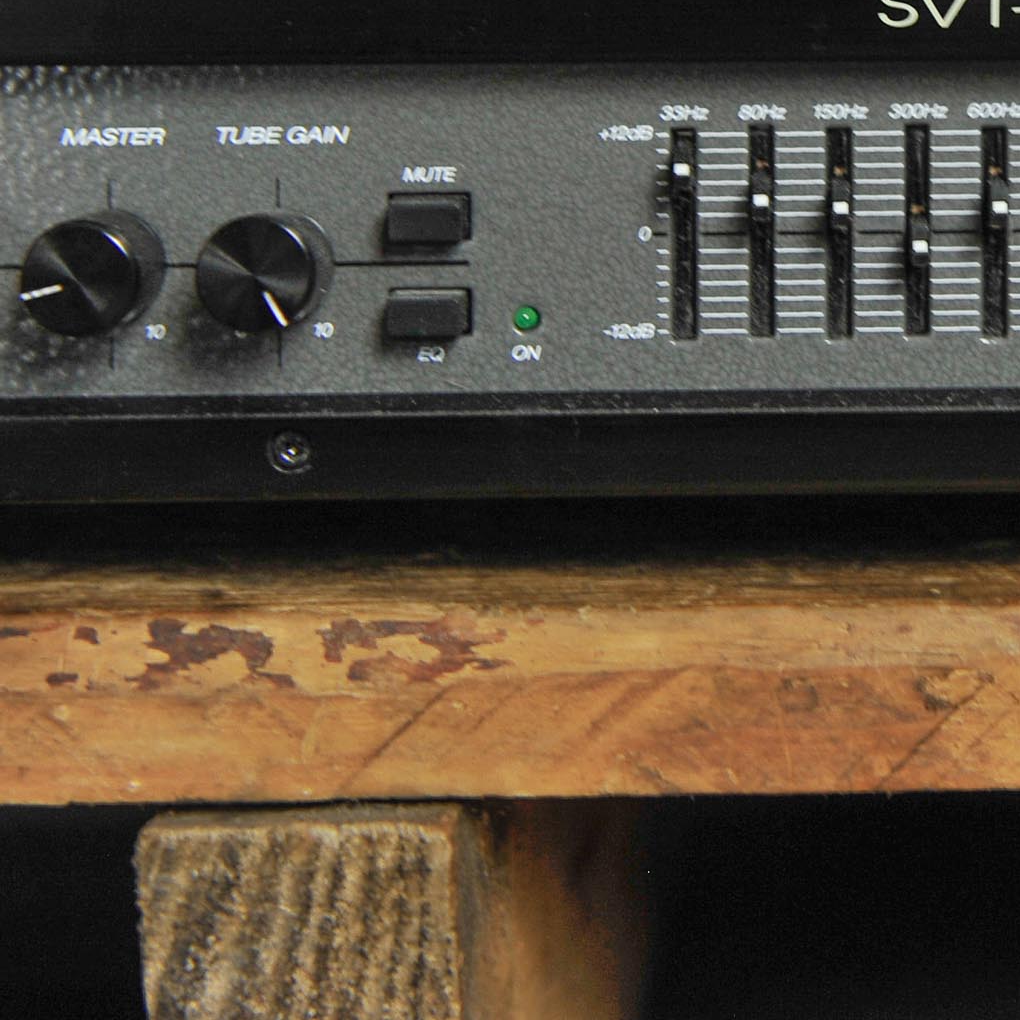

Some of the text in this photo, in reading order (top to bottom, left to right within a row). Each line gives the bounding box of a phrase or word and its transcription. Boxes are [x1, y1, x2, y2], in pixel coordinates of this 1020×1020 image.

[659, 104, 710, 122] 33Hz
[737, 104, 788, 121] 80Hz
[813, 103, 870, 120] 150Hz
[887, 102, 949, 120] 300Hz
[61, 127, 167, 147] MASTER
[216, 125, 351, 145] TUBE GAIN
[598, 124, 654, 141] +12dB
[402, 166, 457, 183] MUTE
[638, 225, 652, 242] 0
[145, 323, 166, 340] 10
[314, 321, 335, 338] 10
[602, 322, 656, 340] -12dB
[417, 347, 445, 363] EQ
[511, 344, 542, 361] ON
